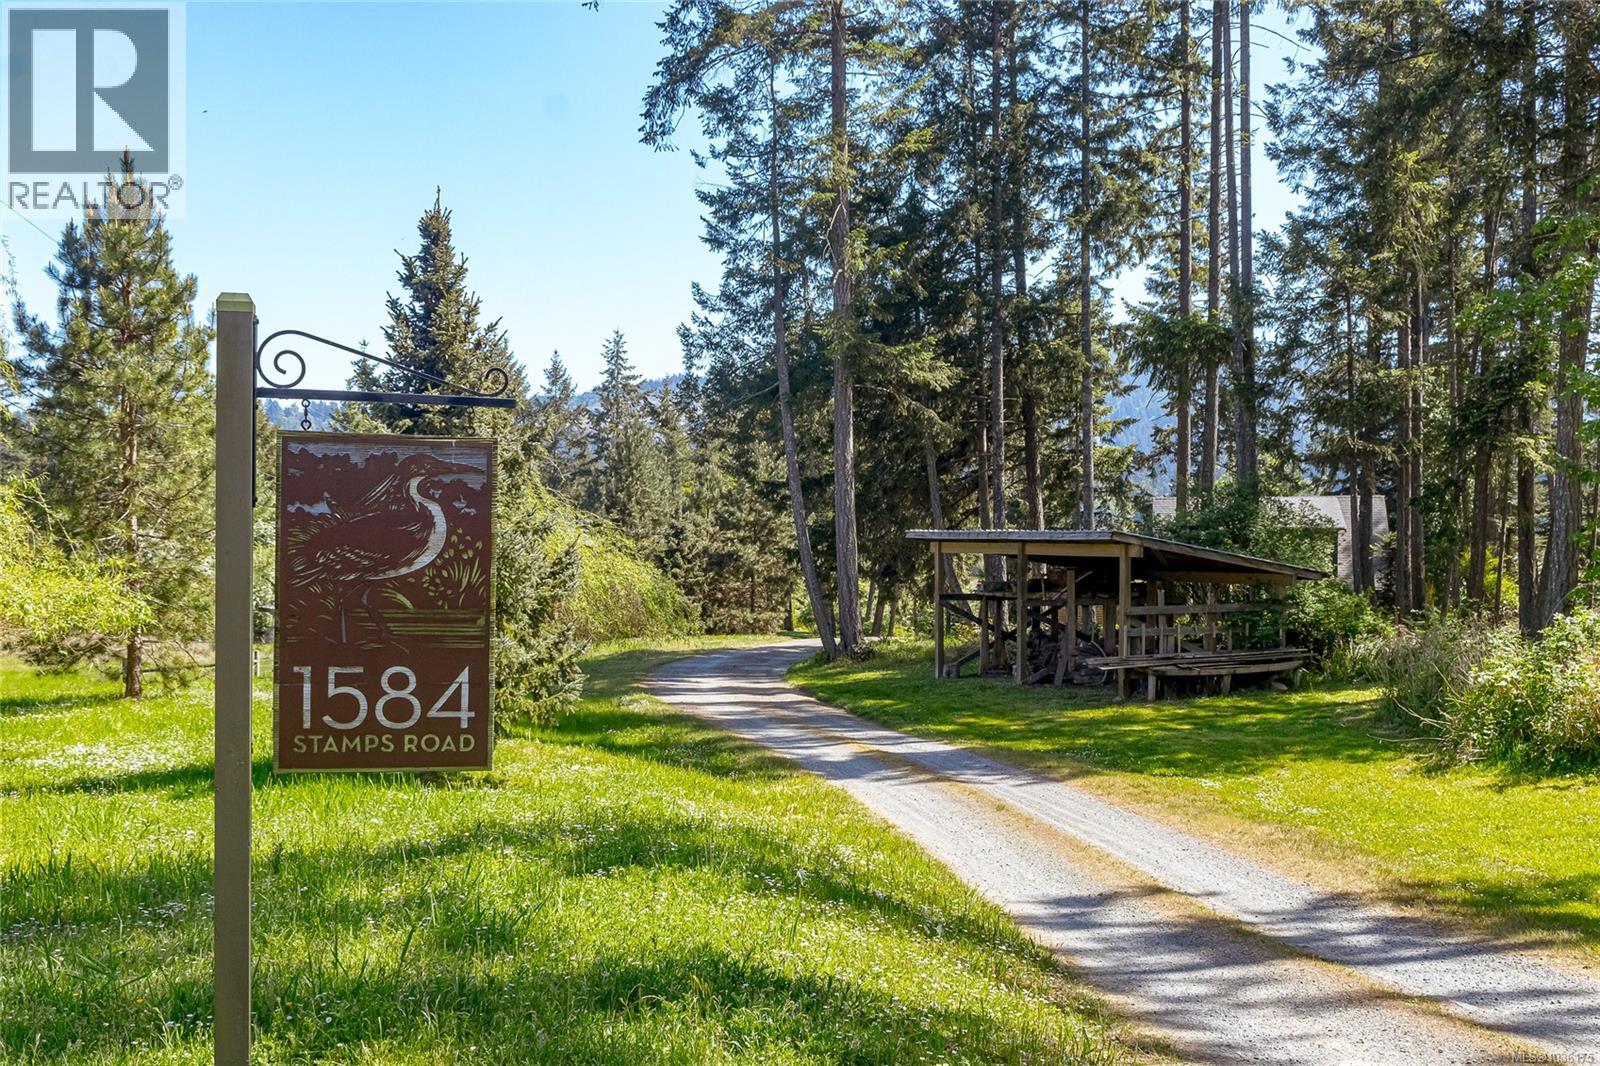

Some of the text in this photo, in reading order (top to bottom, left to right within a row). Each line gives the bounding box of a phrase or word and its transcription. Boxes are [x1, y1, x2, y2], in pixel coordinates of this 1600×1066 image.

[292, 665, 476, 730] 1584
[292, 733, 476, 754] STAMPS ROAD
